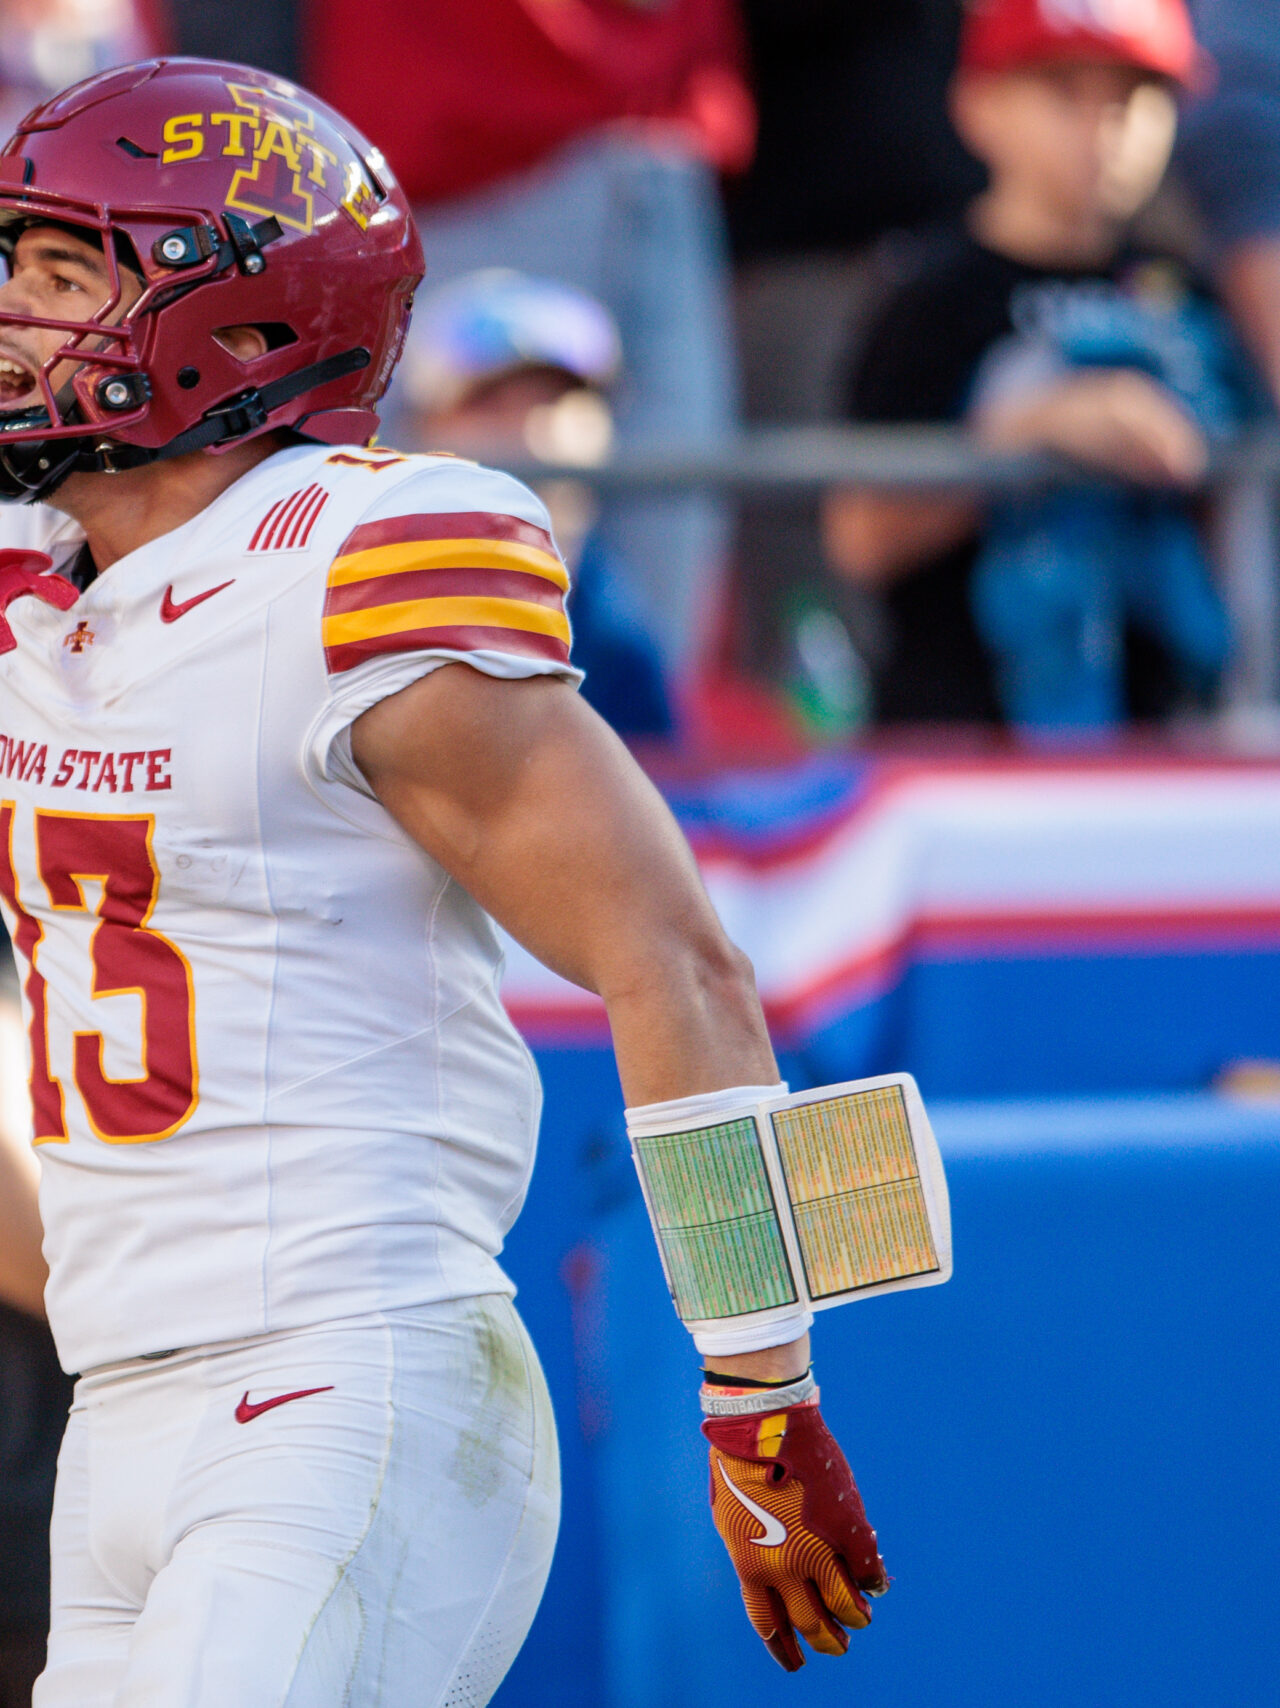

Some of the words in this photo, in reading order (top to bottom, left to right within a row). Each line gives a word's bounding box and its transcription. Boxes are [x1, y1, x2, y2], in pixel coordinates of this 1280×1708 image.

[161, 112, 376, 232] STATE
[51, 748, 172, 794] STATE
[714, 1398, 767, 1415] FOOTBALL
